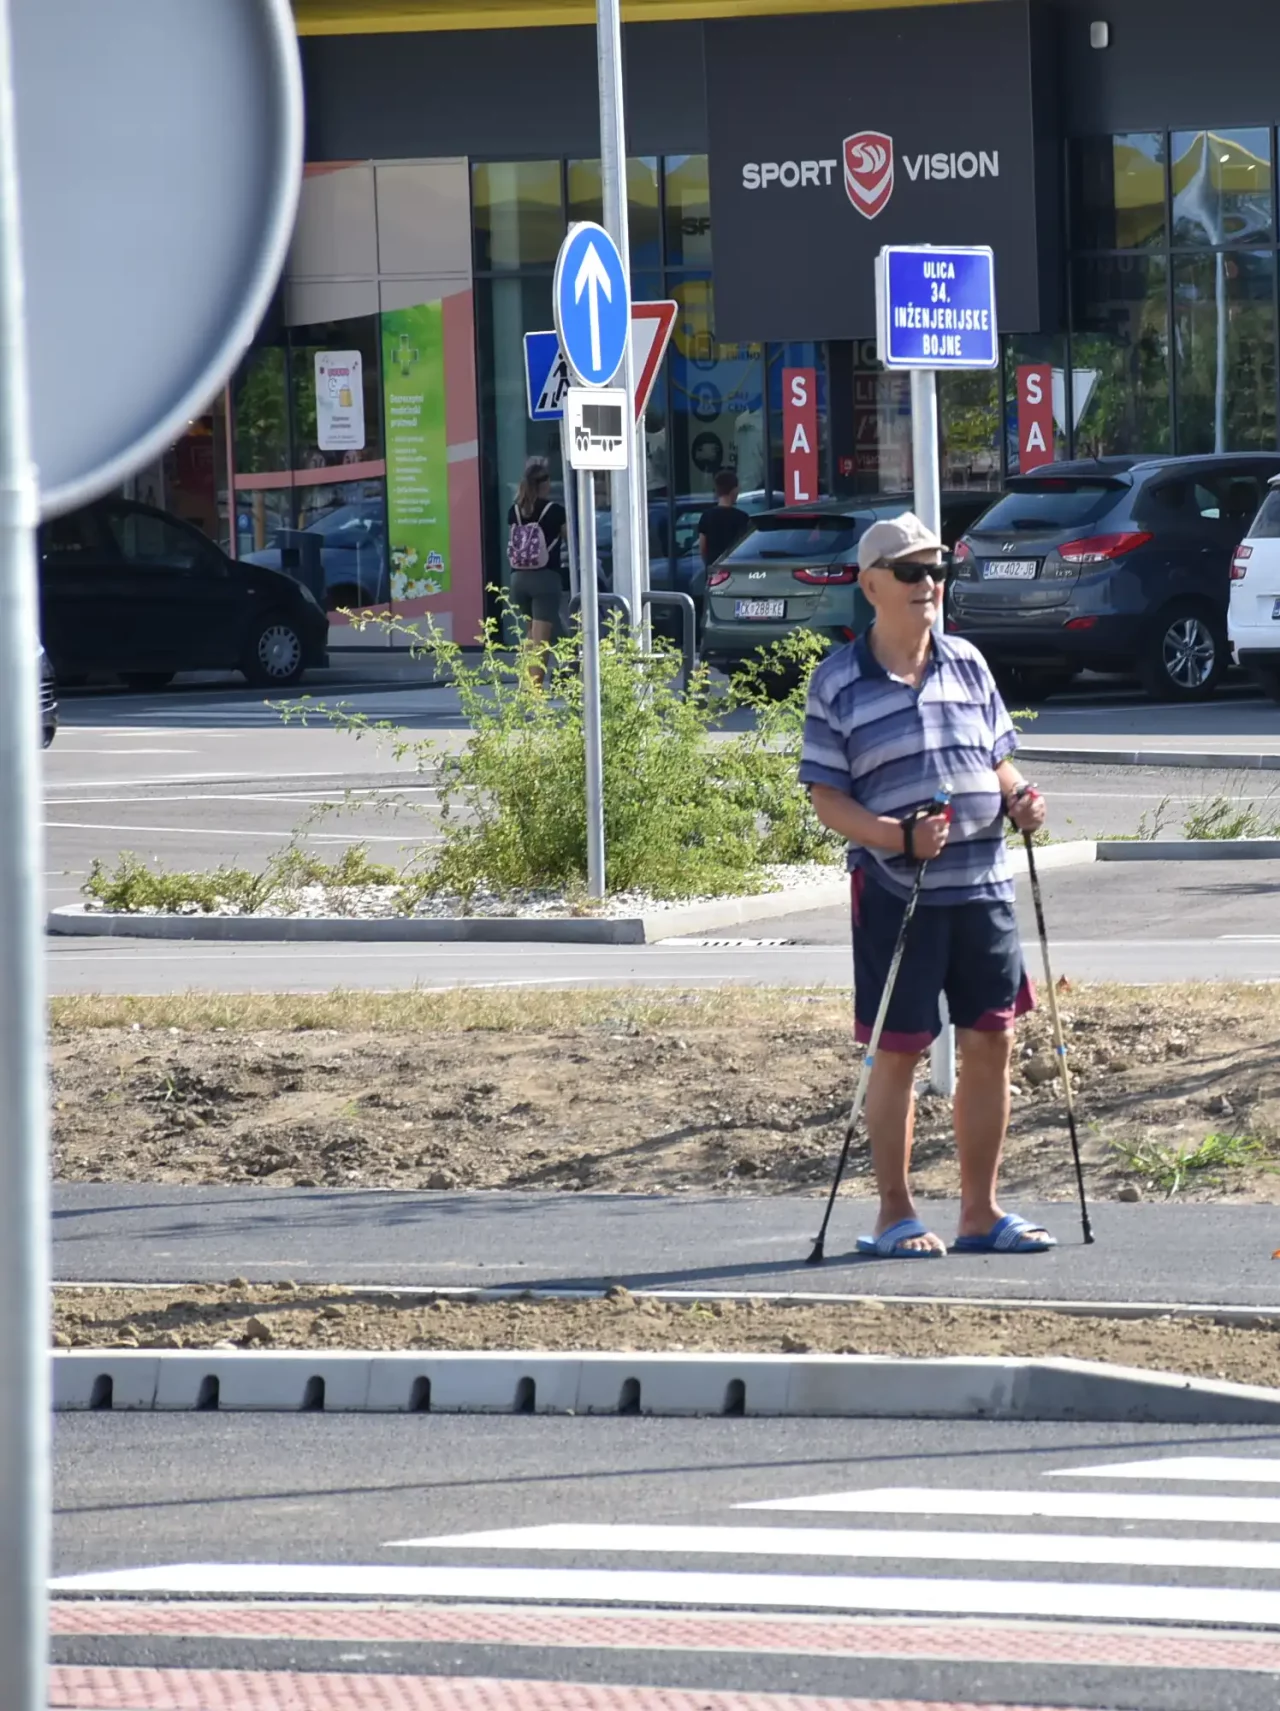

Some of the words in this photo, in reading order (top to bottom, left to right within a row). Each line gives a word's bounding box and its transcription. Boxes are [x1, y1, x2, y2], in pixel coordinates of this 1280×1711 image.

[742, 160, 837, 190] SPORT
[902, 151, 1000, 181] VISION
[923, 261, 955, 279] ULICA
[930, 281, 951, 303] 34.
[894, 302, 989, 331] INŽENJERIJSKE
[922, 334, 962, 356] BOJNE
[790, 376, 811, 501] SAL
[1004, 561, 1034, 573] 402-JB
